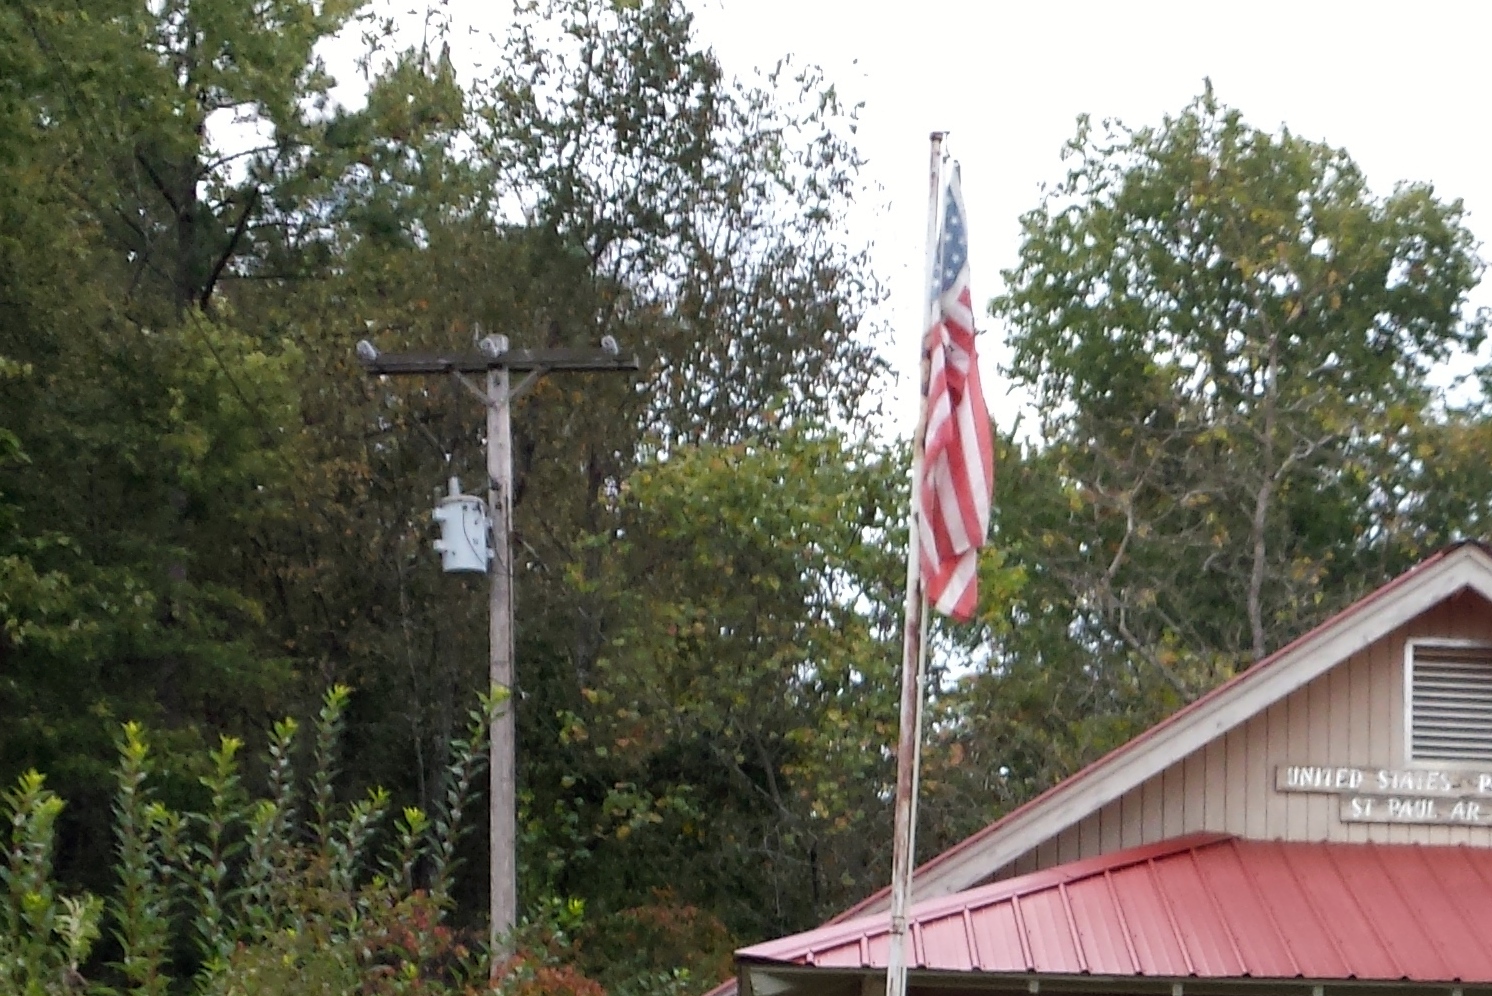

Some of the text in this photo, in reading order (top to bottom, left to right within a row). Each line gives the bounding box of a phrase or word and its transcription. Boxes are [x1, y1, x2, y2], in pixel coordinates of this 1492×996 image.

[1287, 766, 1363, 788] UNITED
[1378, 772, 1451, 792] STATES
[1351, 798, 1373, 817] ST
[1388, 799, 1437, 819] PAUL
[1450, 801, 1480, 821] AR
